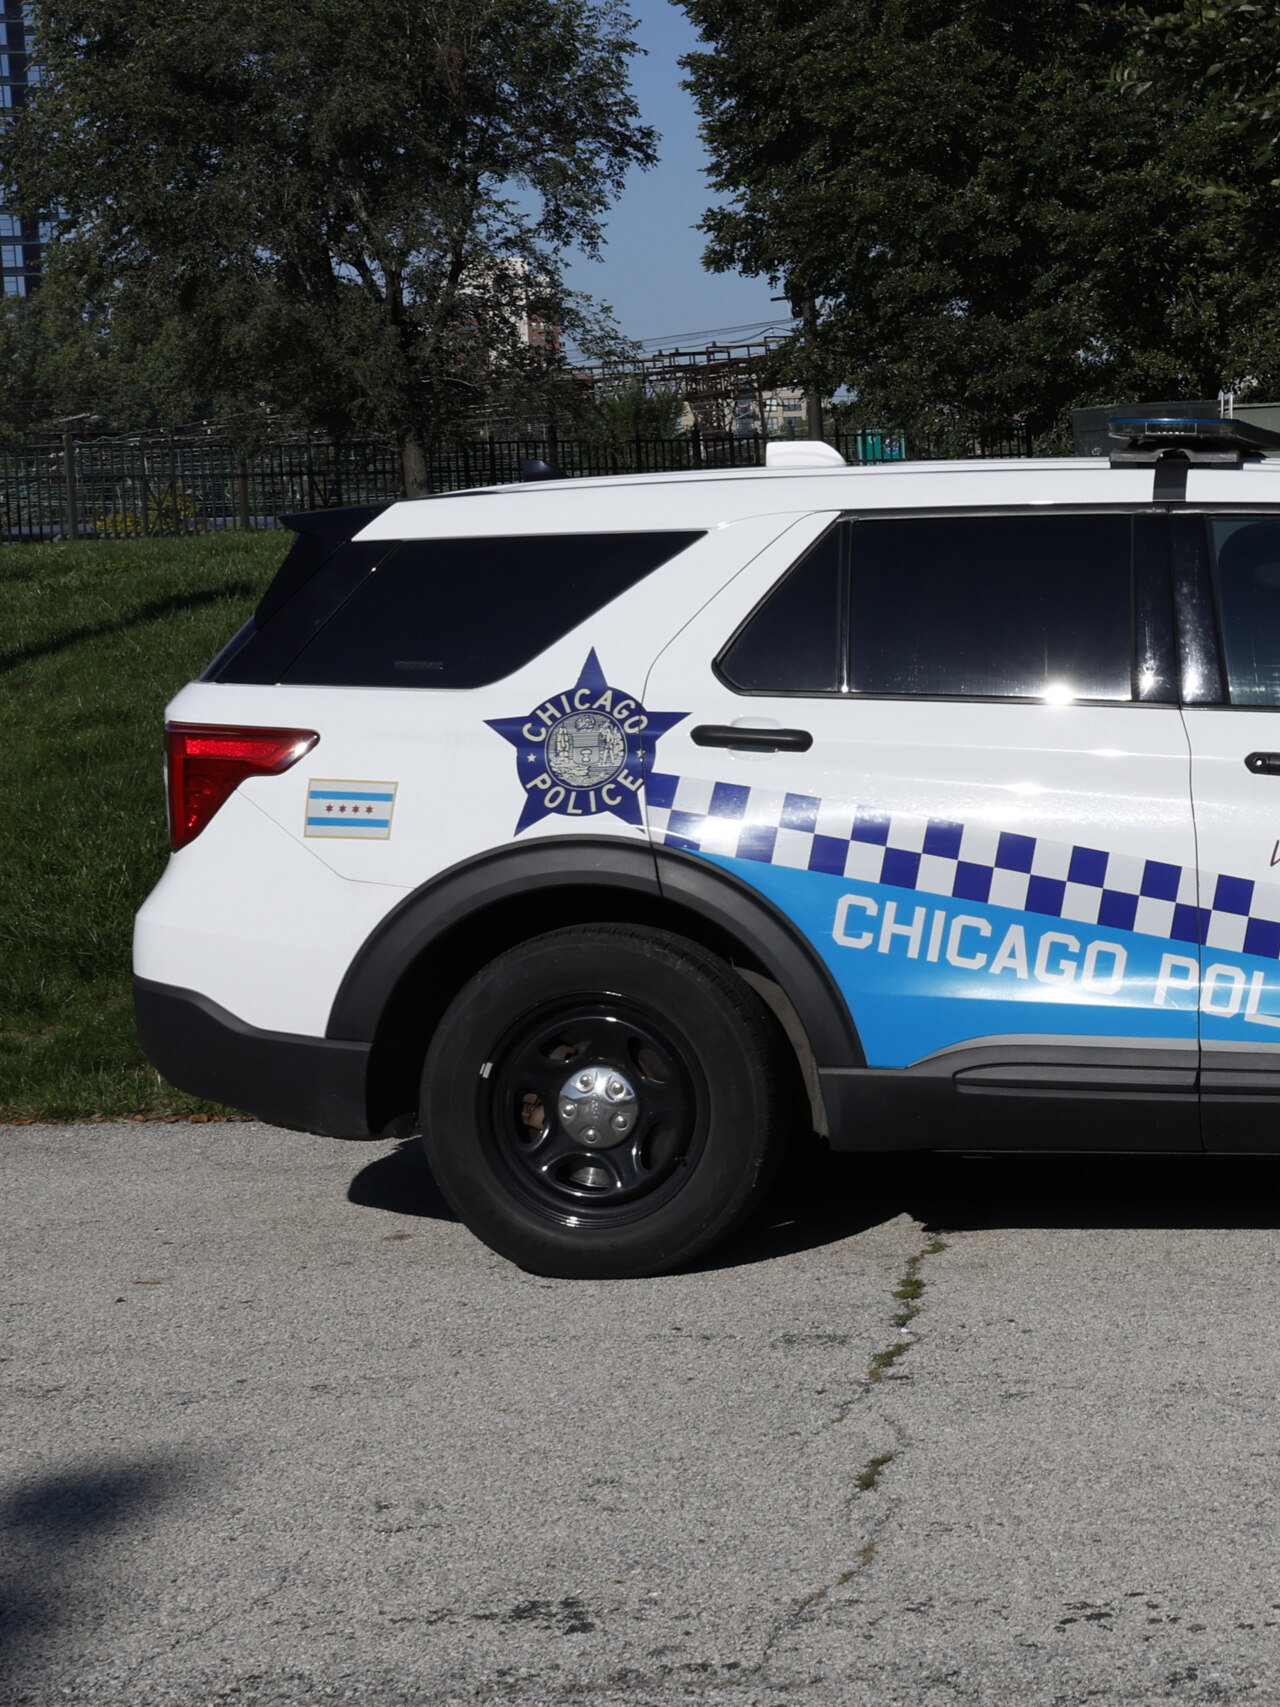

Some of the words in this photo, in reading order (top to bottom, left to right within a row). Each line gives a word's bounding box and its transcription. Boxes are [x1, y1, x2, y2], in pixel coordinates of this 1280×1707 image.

[522, 688, 648, 742] CHICAGO
[526, 769, 643, 814] POLICE
[831, 894, 1128, 995] CHICAGO
